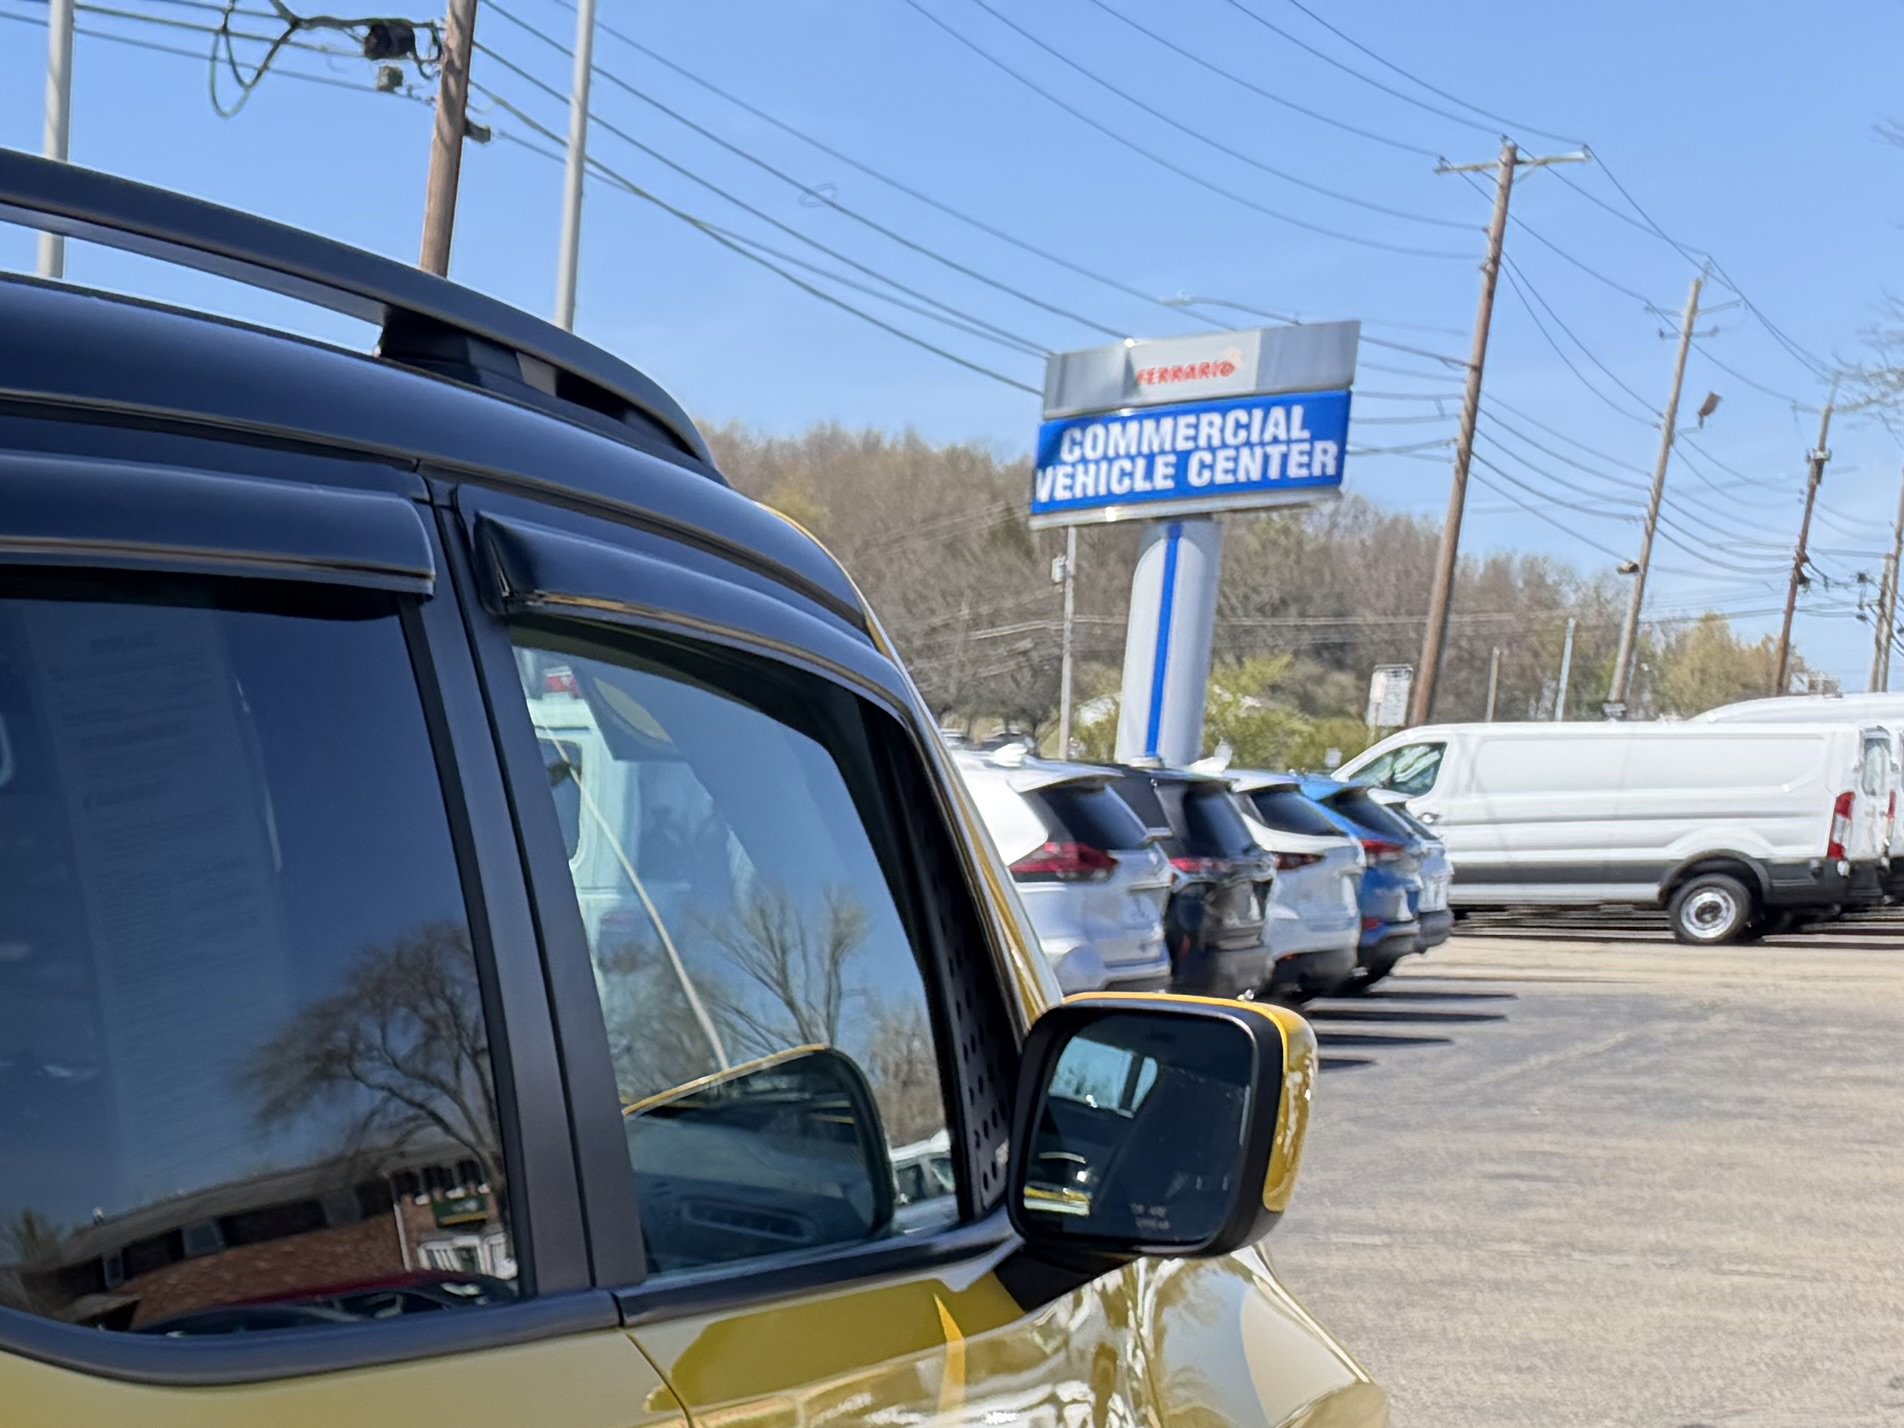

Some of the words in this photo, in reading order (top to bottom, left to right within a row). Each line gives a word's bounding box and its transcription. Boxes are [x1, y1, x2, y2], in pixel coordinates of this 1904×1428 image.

[1059, 405, 1310, 463] COMMERCIAL
[1035, 450, 1177, 503] VEHICLE
[1186, 439, 1338, 487] CENTER
